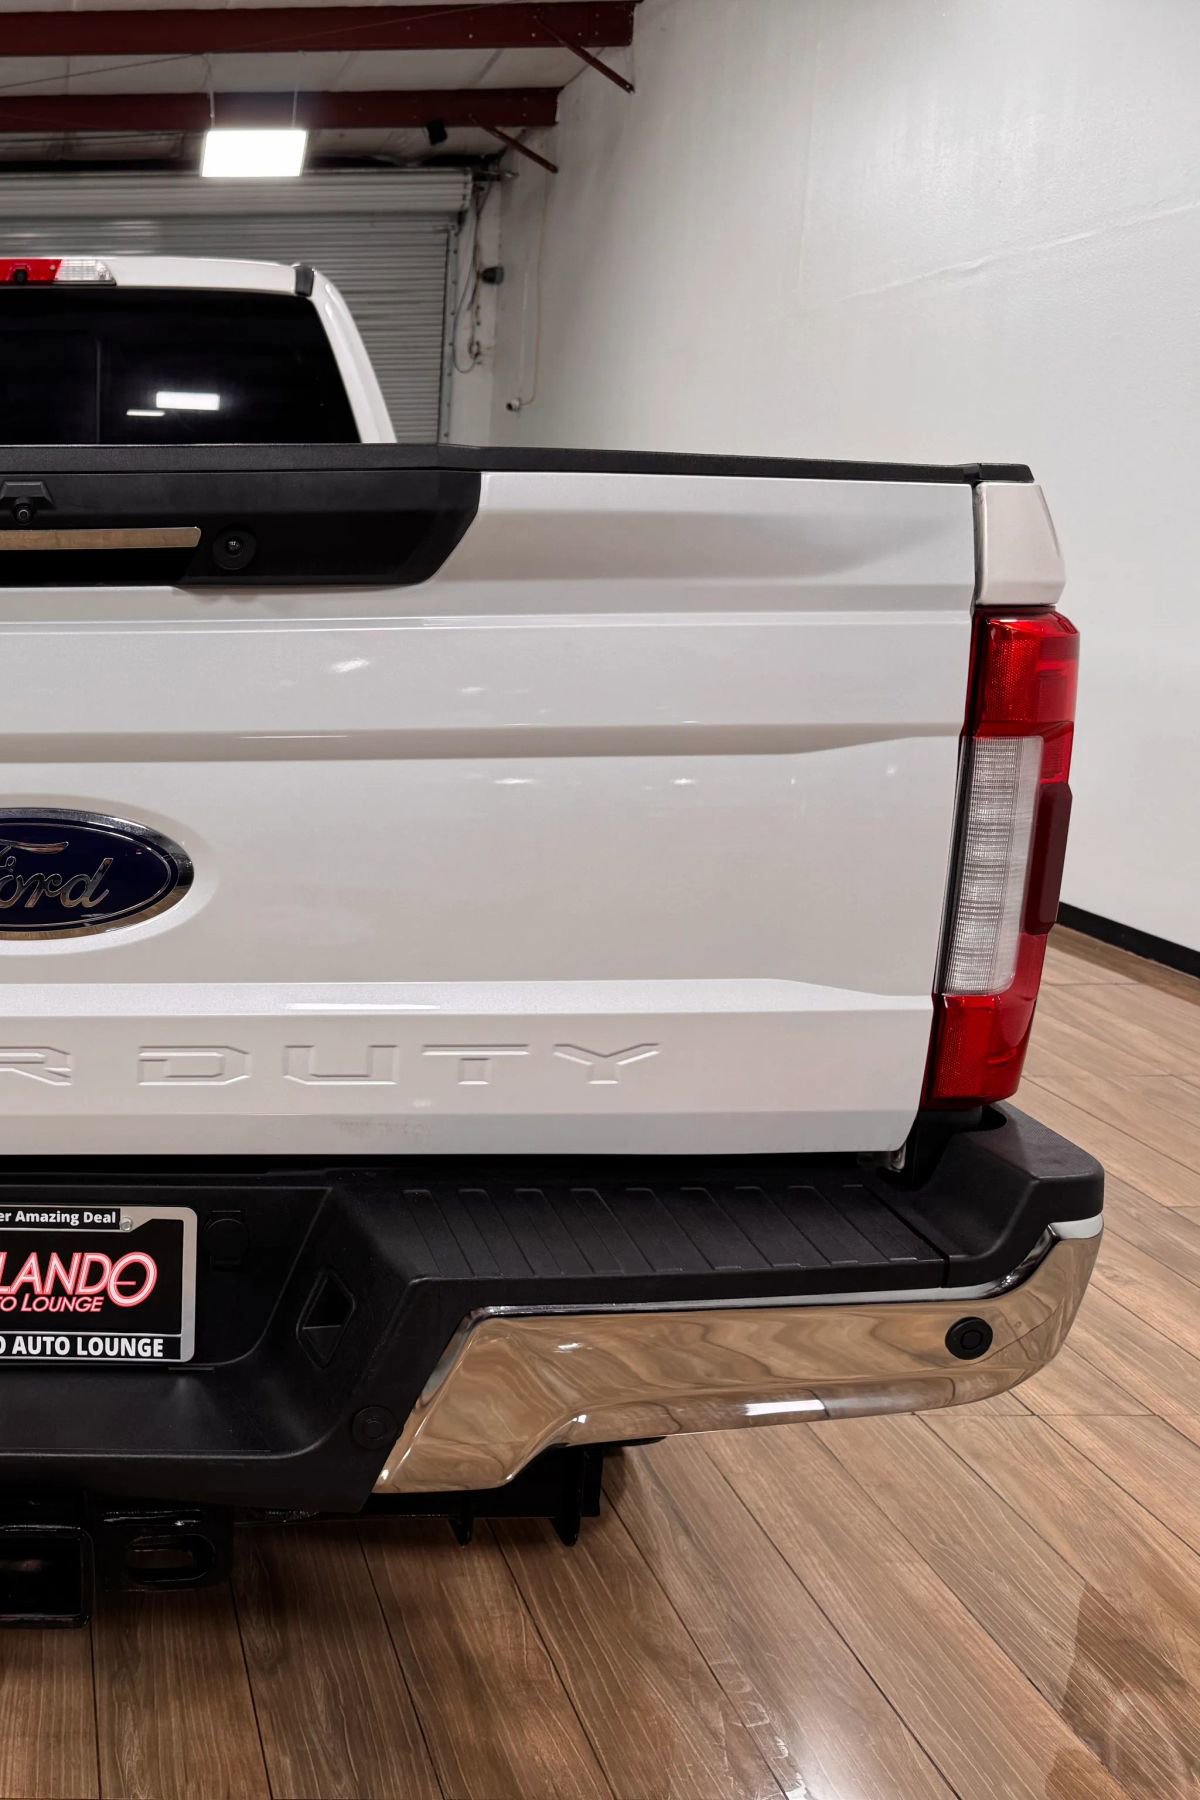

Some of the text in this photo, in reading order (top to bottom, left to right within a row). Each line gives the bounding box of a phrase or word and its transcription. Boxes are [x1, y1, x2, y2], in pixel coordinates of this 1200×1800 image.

[137, 1043, 661, 1086] DUTY
[15, 1210, 80, 1226] Amazing
[83, 1211, 117, 1224] Deal
[20, 1295, 104, 1313] LOUNGE
[11, 1336, 71, 1357] AUTO
[76, 1337, 164, 1358] LOUNGE
